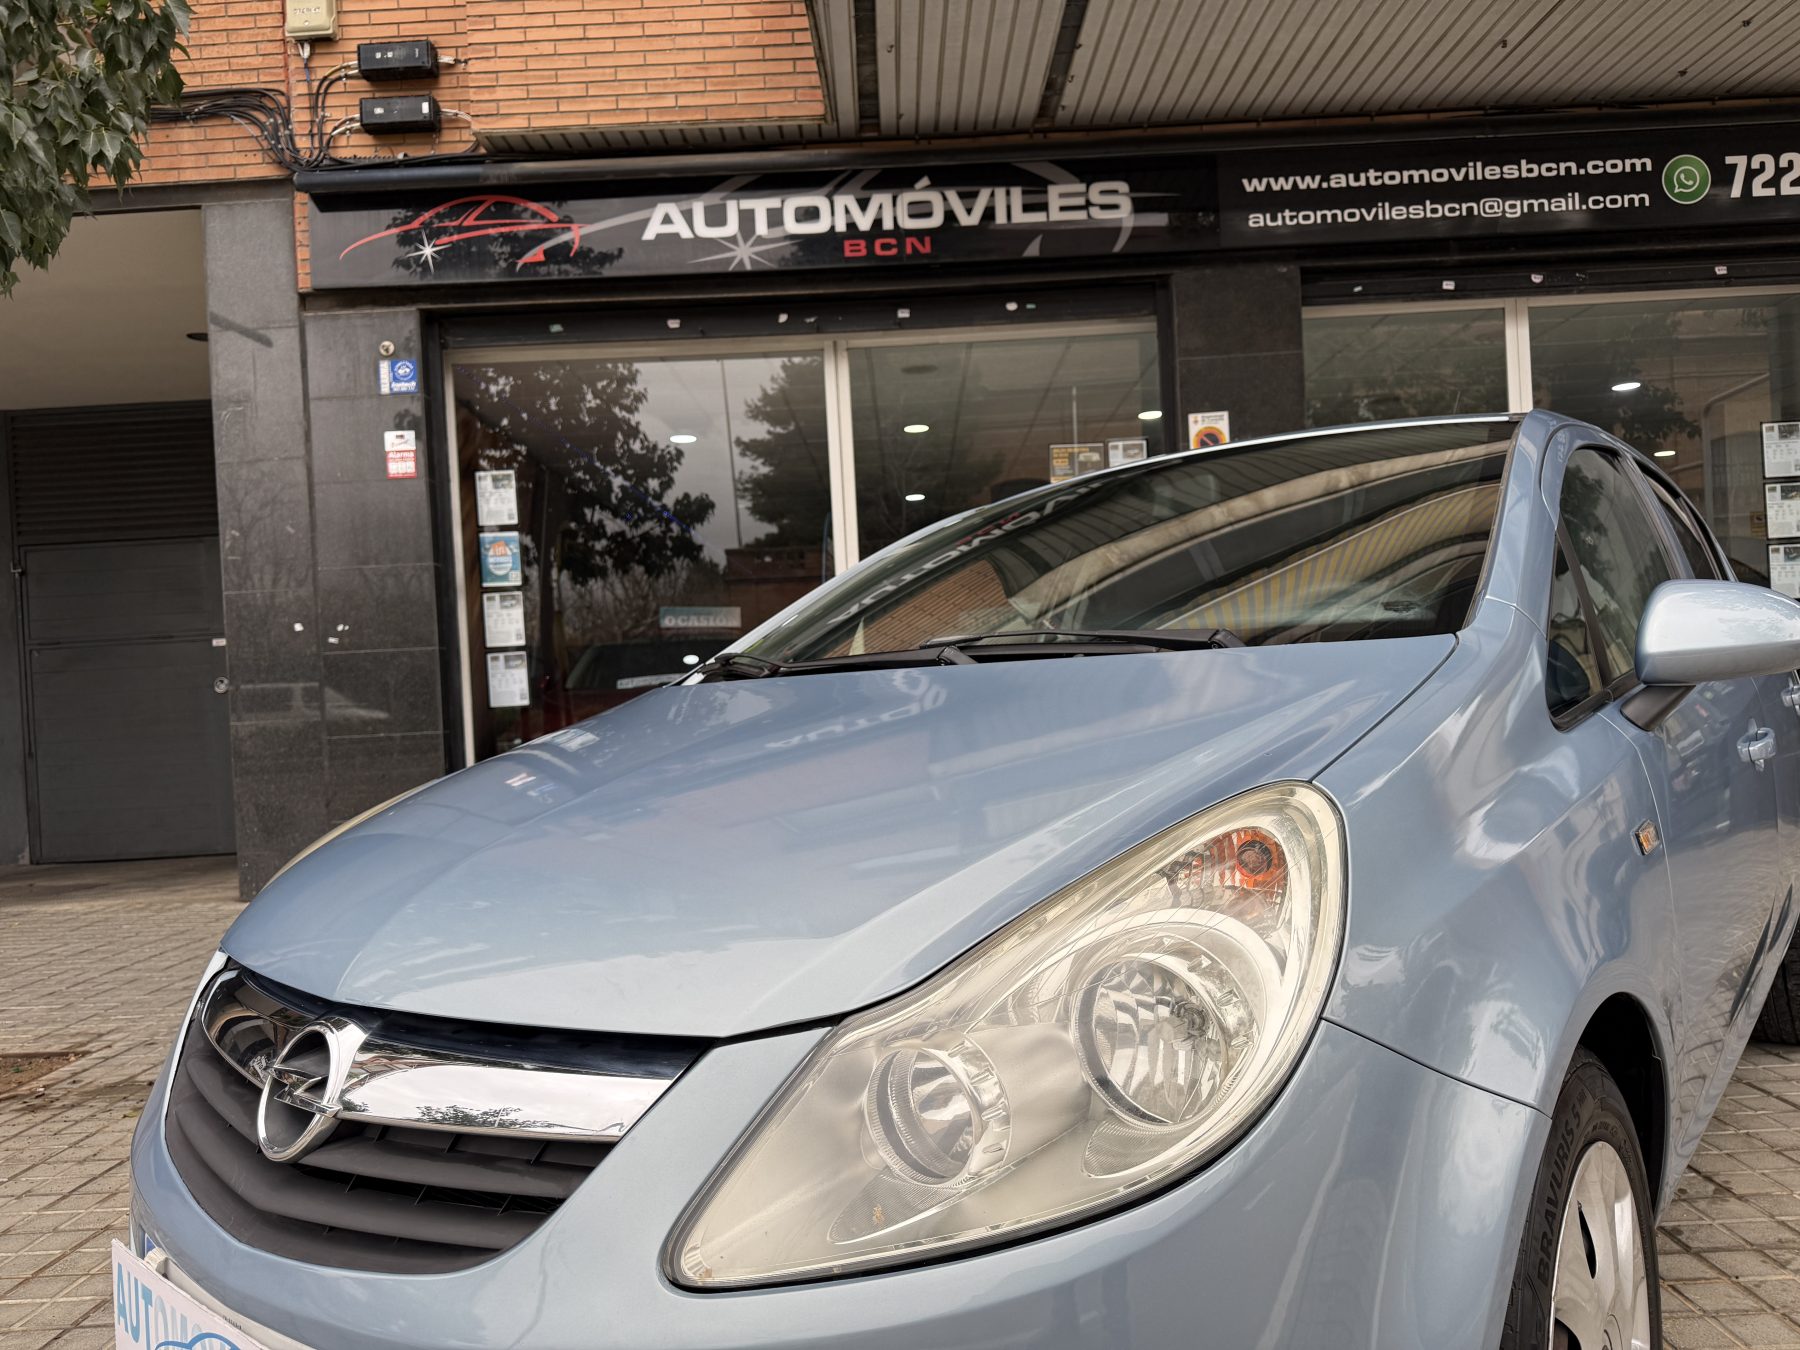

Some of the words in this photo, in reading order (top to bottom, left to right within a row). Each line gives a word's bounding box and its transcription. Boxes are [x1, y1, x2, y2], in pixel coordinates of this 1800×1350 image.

[1242, 157, 1652, 192] www.automovilesbcn.com
[1724, 152, 1800, 199] 722
[641, 175, 1132, 242] AUTOMÓVILES
[1248, 191, 1650, 228] automovilesbcn@gmail.com
[843, 236, 932, 257] BCN
[1536, 1118, 1577, 1289] BRAVURIS
